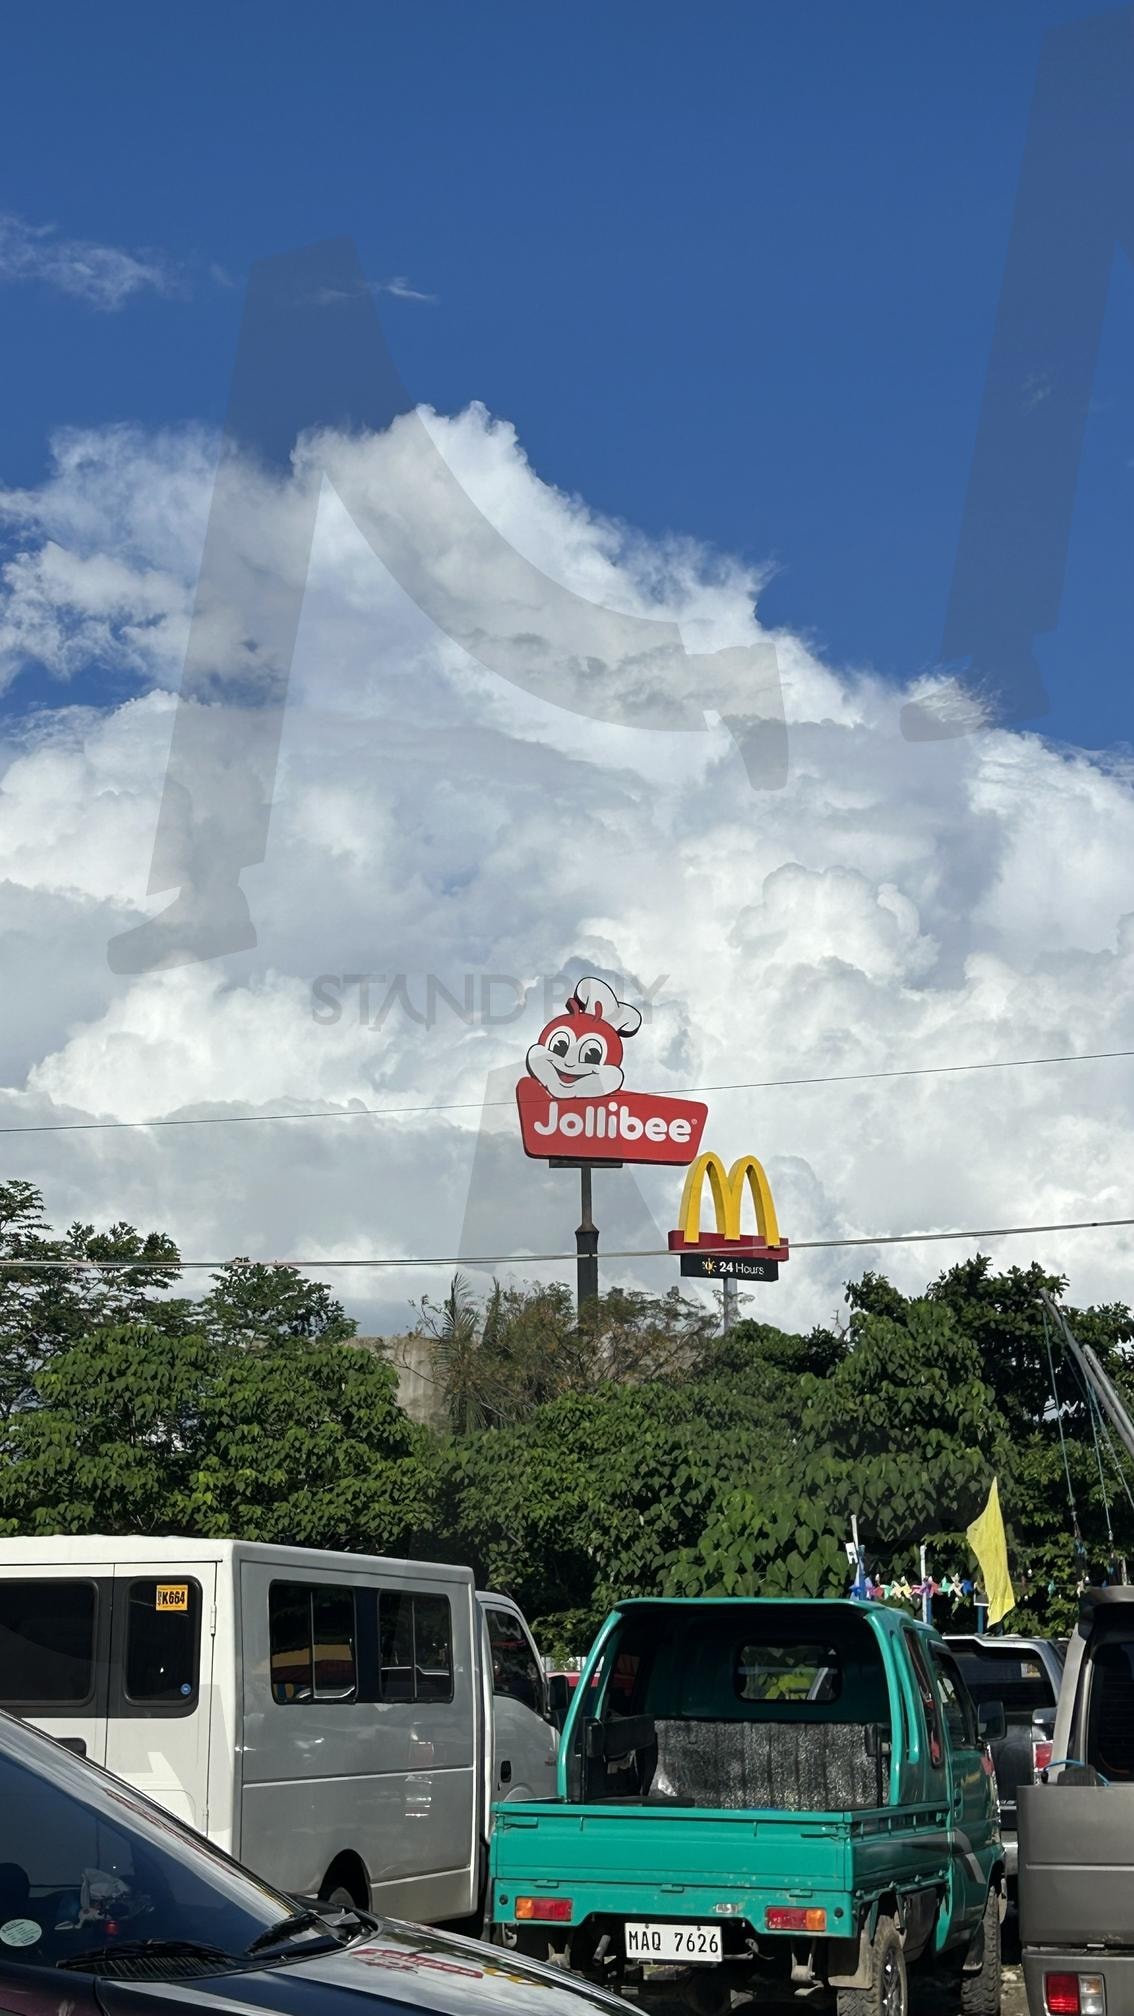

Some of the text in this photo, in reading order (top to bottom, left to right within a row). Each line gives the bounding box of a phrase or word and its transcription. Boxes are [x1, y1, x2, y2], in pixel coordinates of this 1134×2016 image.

[533, 1101, 692, 1143] Jollibee
[719, 1262, 764, 1275] 24 Hours
[628, 1930, 719, 1953] MAQ 7626
